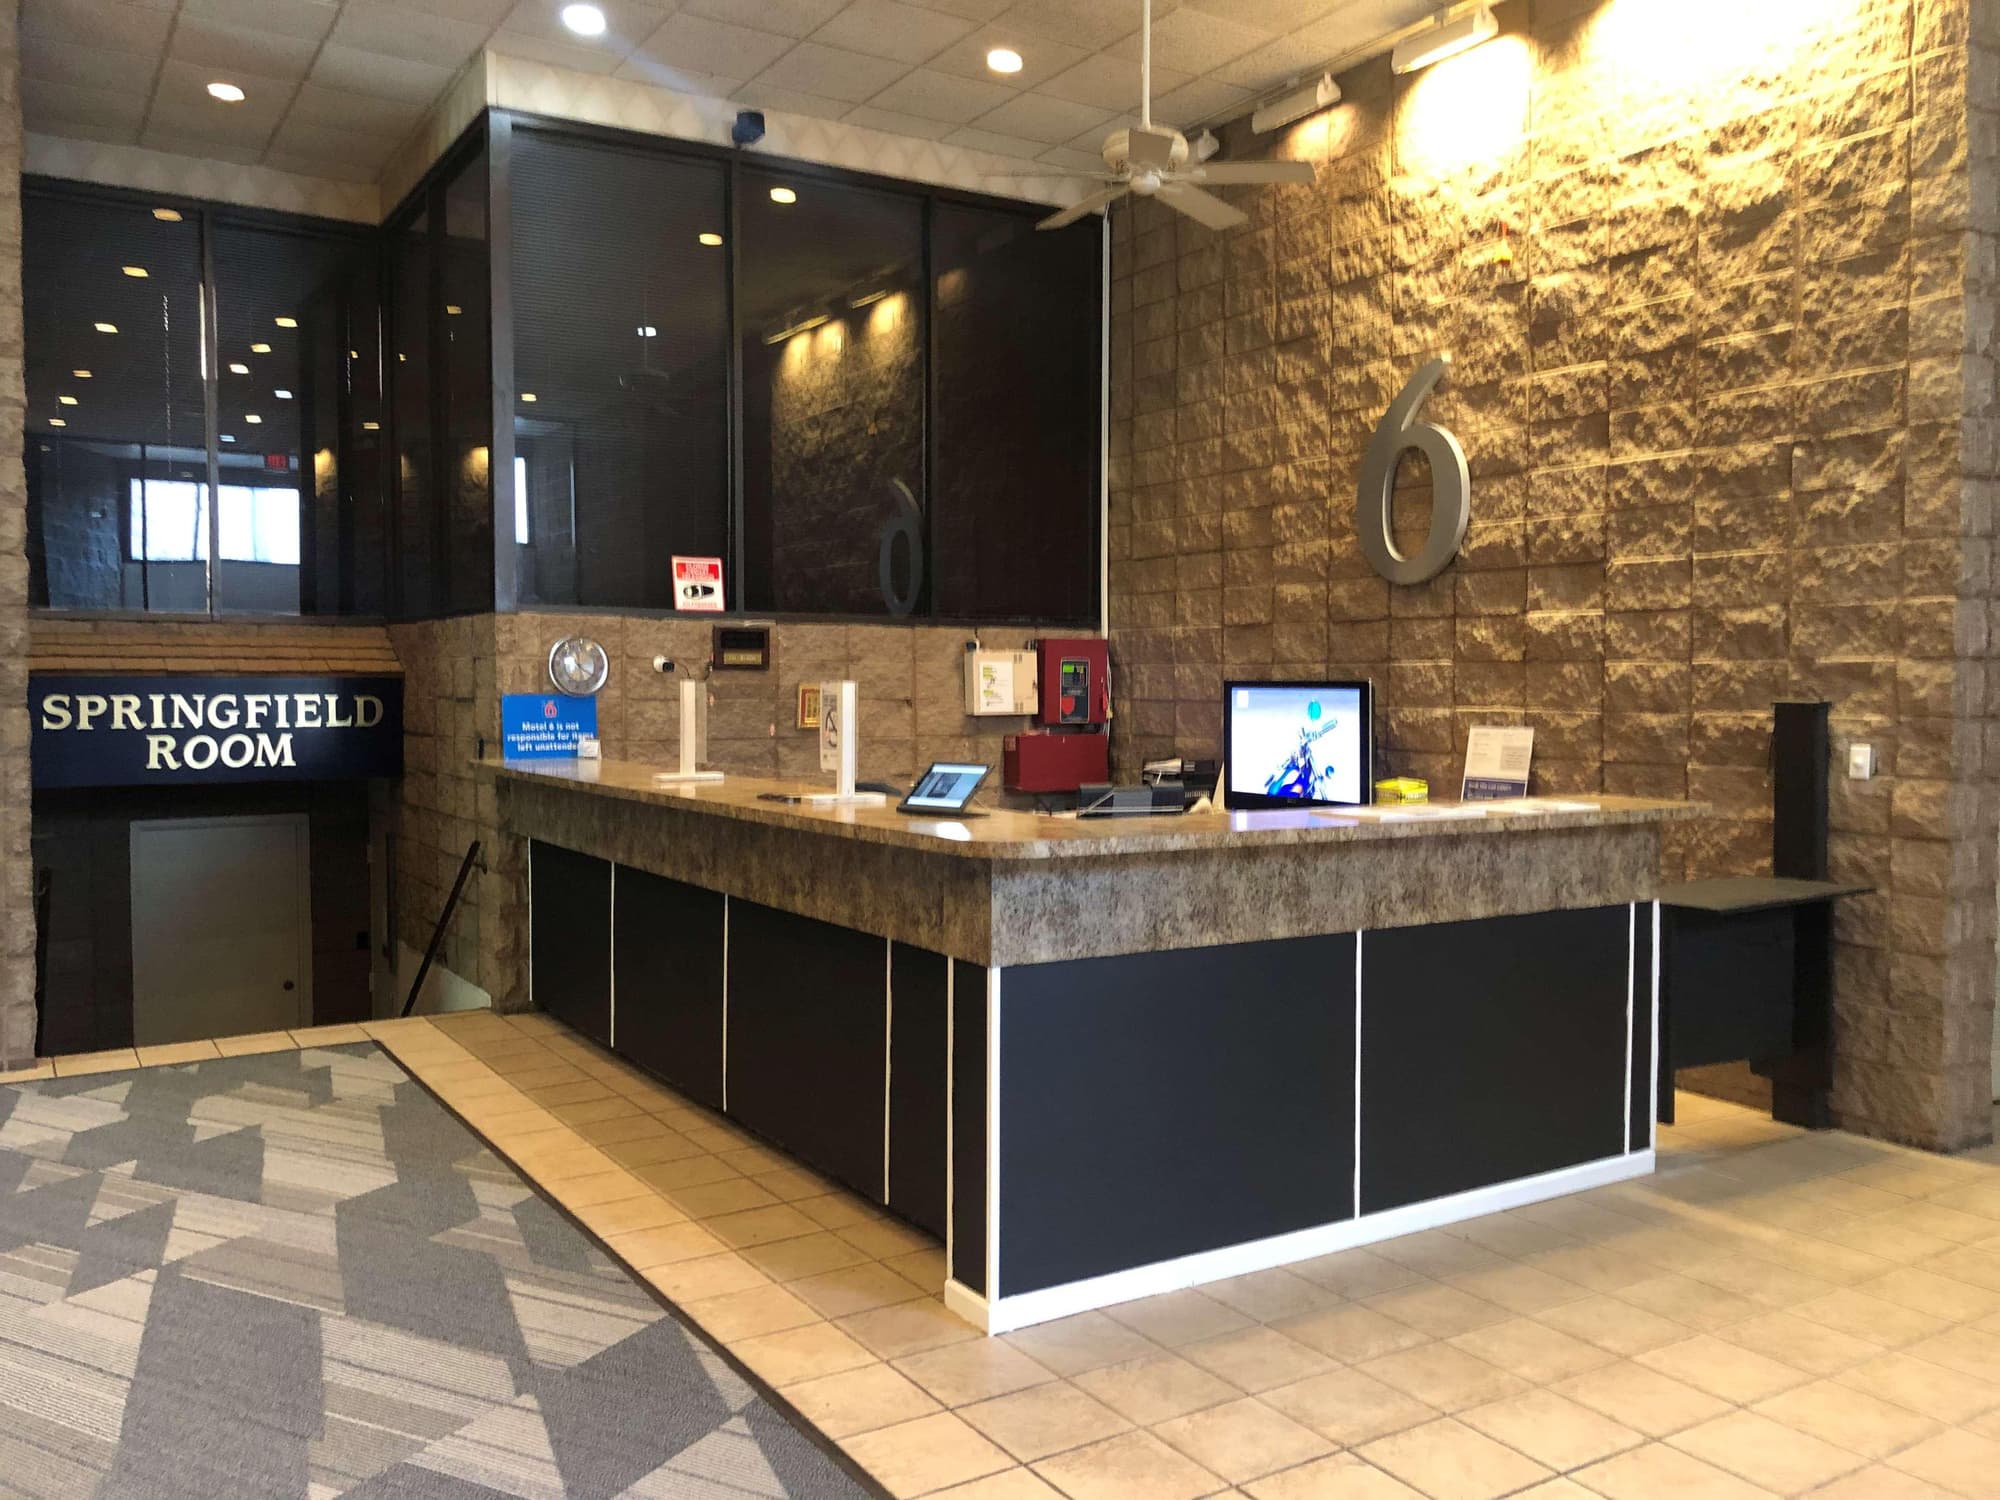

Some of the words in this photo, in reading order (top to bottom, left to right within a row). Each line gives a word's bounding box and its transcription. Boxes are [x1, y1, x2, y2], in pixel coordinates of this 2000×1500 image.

[1357, 351, 1470, 585] 6
[42, 693, 384, 731] SPRINGFIELD
[507, 731, 555, 742] responsible
[557, 731, 570, 741] for
[522, 721, 547, 731] Motel
[549, 722, 555, 731] 6
[556, 721, 564, 731] is
[565, 722, 579, 731] not
[145, 733, 297, 770] ROOM
[517, 742, 533, 752] left
[535, 742, 577, 751] unattende
